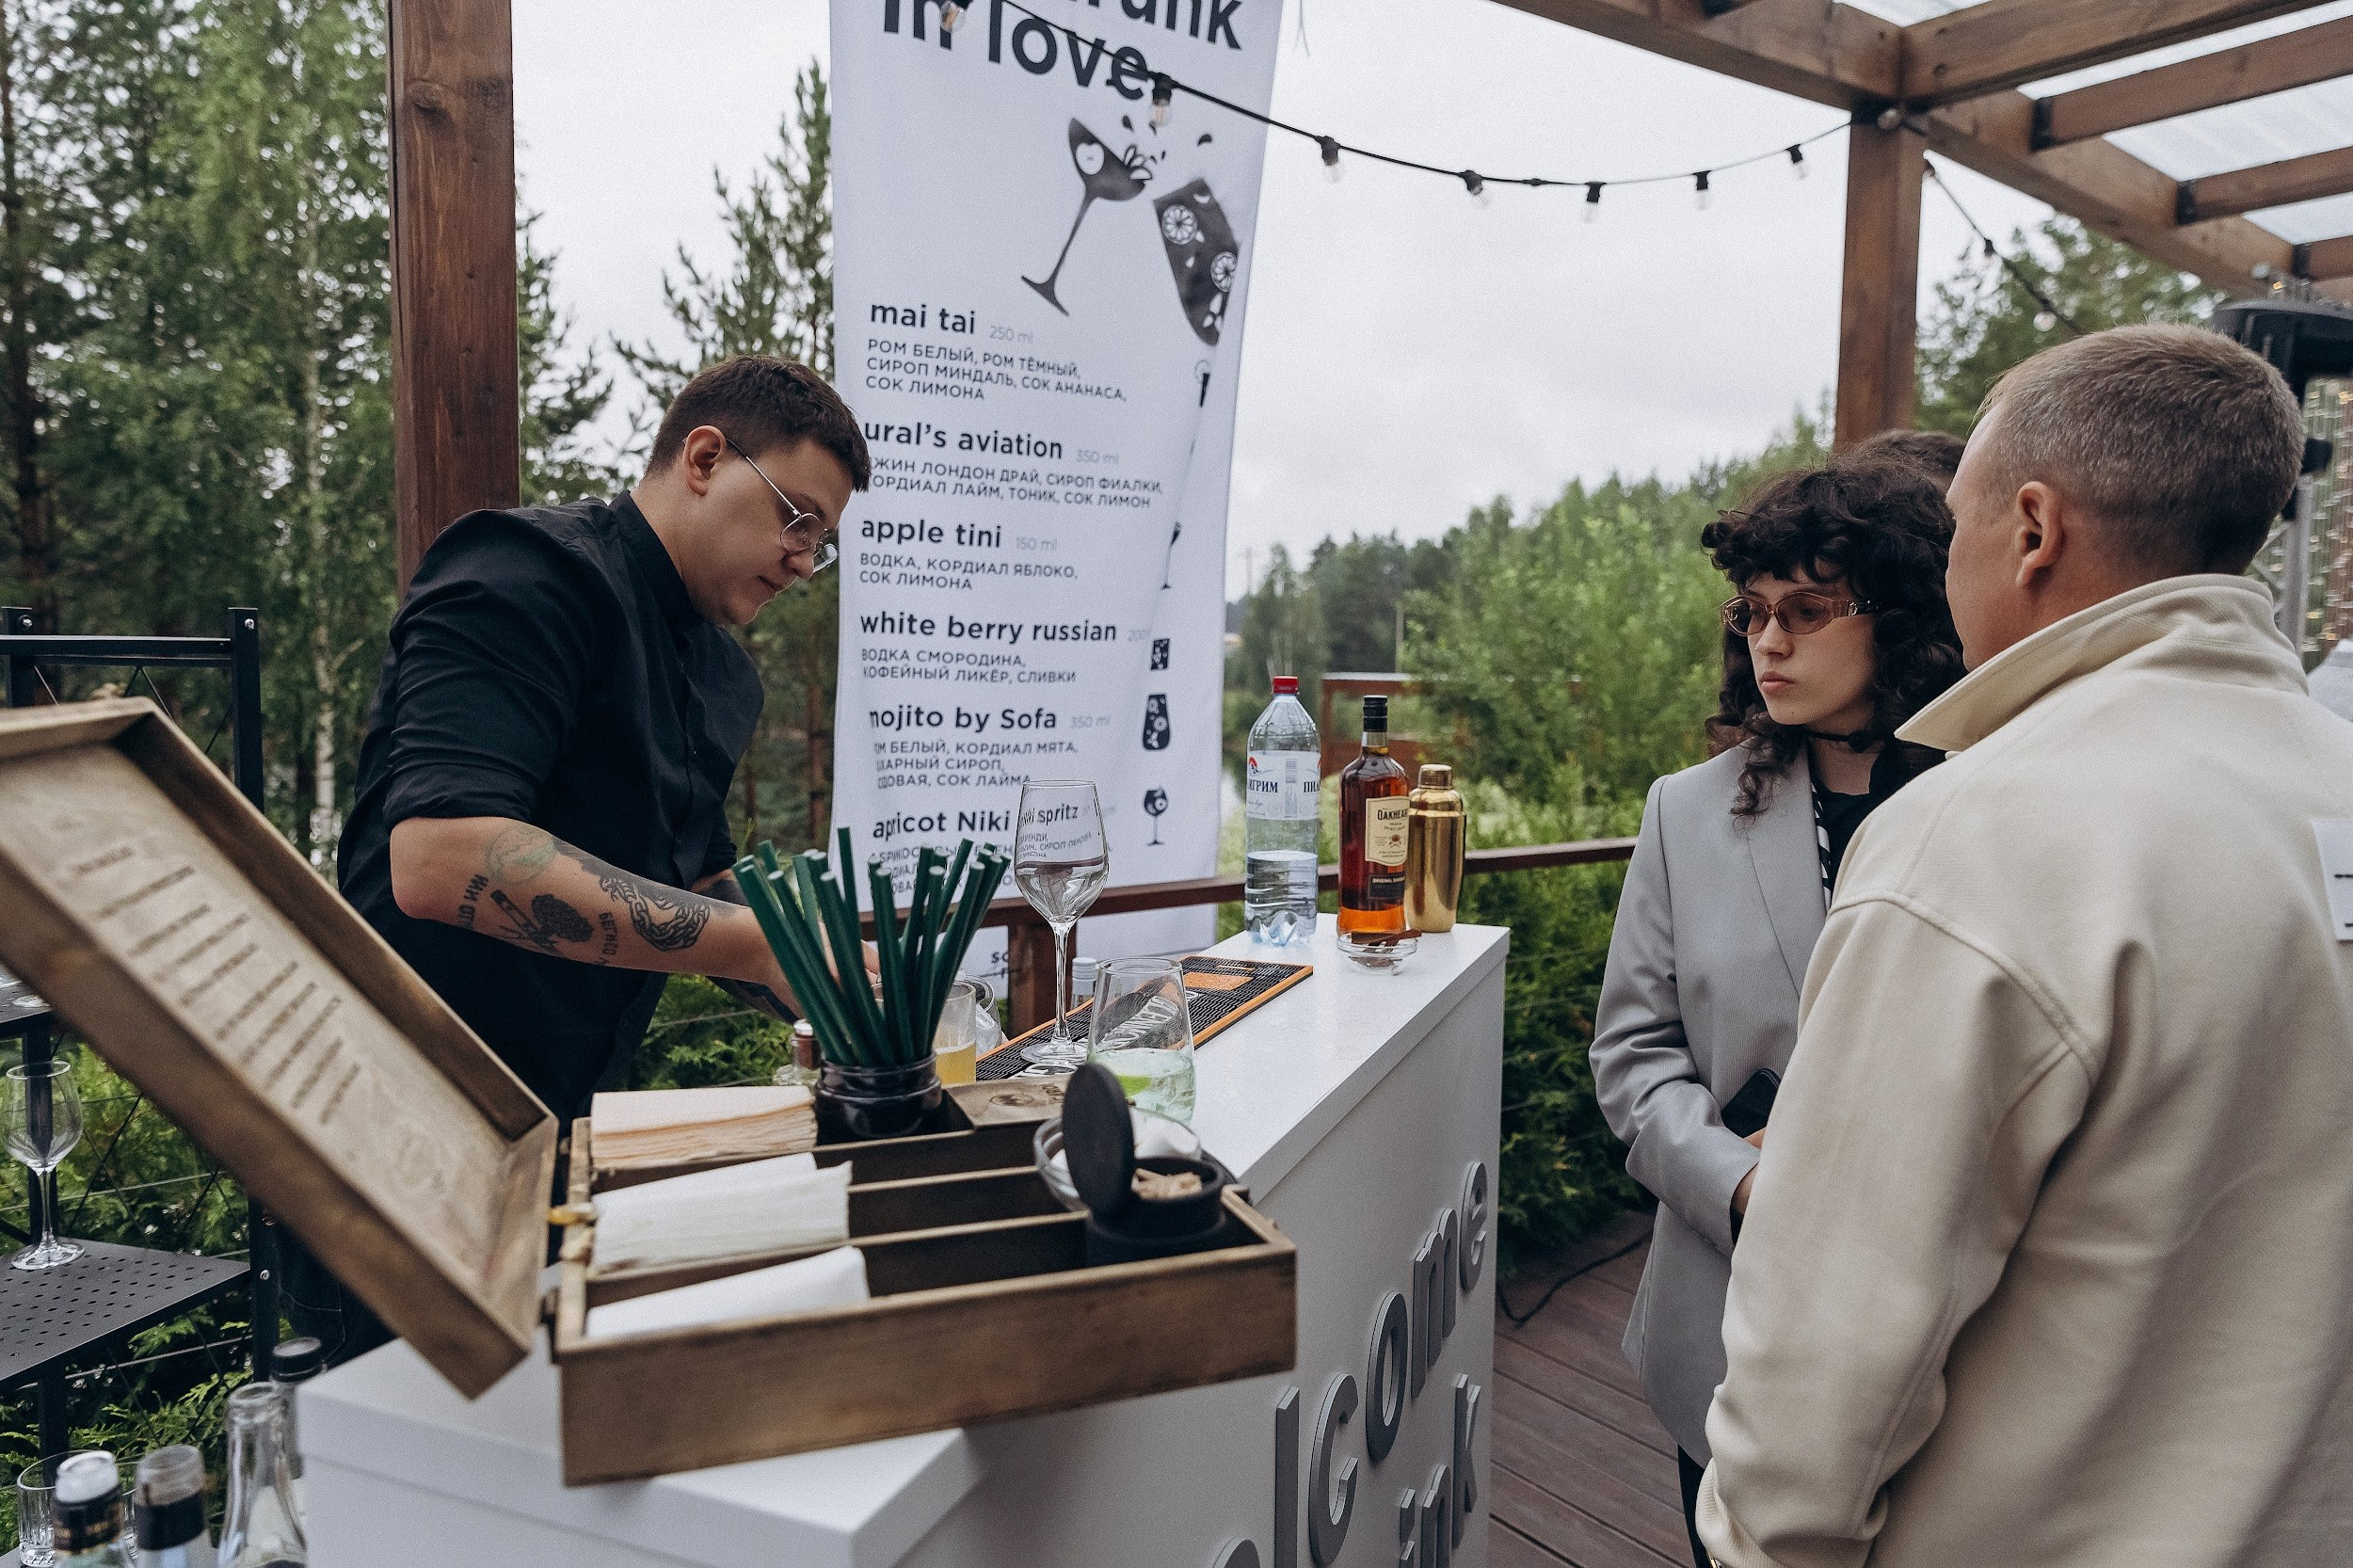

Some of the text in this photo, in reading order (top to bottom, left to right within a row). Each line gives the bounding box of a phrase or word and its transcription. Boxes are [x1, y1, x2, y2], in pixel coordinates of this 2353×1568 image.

[988, 0, 1148, 100] love
[870, 303, 926, 328] mai
[938, 307, 976, 335] tai
[988, 325, 1015, 342] 250
[868, 339, 1081, 379] РОМ БЕЛЫЙ, РОМ ТЁМНЫЙ,
[866, 376, 984, 401] СОК ЛИМОНА
[867, 357, 1128, 403] СИРОП МИНДАЛЬ, СОК АНАНАСА,
[957, 429, 1063, 459] aviation
[870, 457, 916, 473] ЖИН
[921, 462, 996, 481] ЛОНДОН
[1000, 467, 1042, 486] ДРАЙ,
[1046, 473, 1095, 488] СИРОП
[870, 474, 1151, 509] ОРДИАЛ ЛАЙМ, ТОНИК, СОК ЛИМОН
[861, 520, 943, 545] apple
[955, 523, 1001, 548] tini
[859, 570, 972, 591] СОК ЛИМОНА
[860, 553, 1079, 580] ВОДКА, КОРДИАЛ ЯБЛОКО,
[859, 612, 936, 636] white
[948, 616, 1023, 645] berry
[1032, 619, 1116, 642] russian
[916, 650, 1027, 667] СМОРОДИНА,
[954, 665, 1013, 684] ЛИКЁР,
[1016, 670, 1077, 683] СЛИВКИ
[955, 706, 990, 733] by
[1000, 708, 1057, 730] Sofa
[890, 739, 950, 756] БЕЛЫЙ,
[955, 742, 1032, 756] КОРДИАЛ
[1036, 741, 1079, 755] МЯТА,
[936, 775, 970, 787] СОК
[957, 810, 1010, 832] Niki
[1037, 803, 1079, 825] spritz
[1210, 1161, 1488, 1568] lcome
